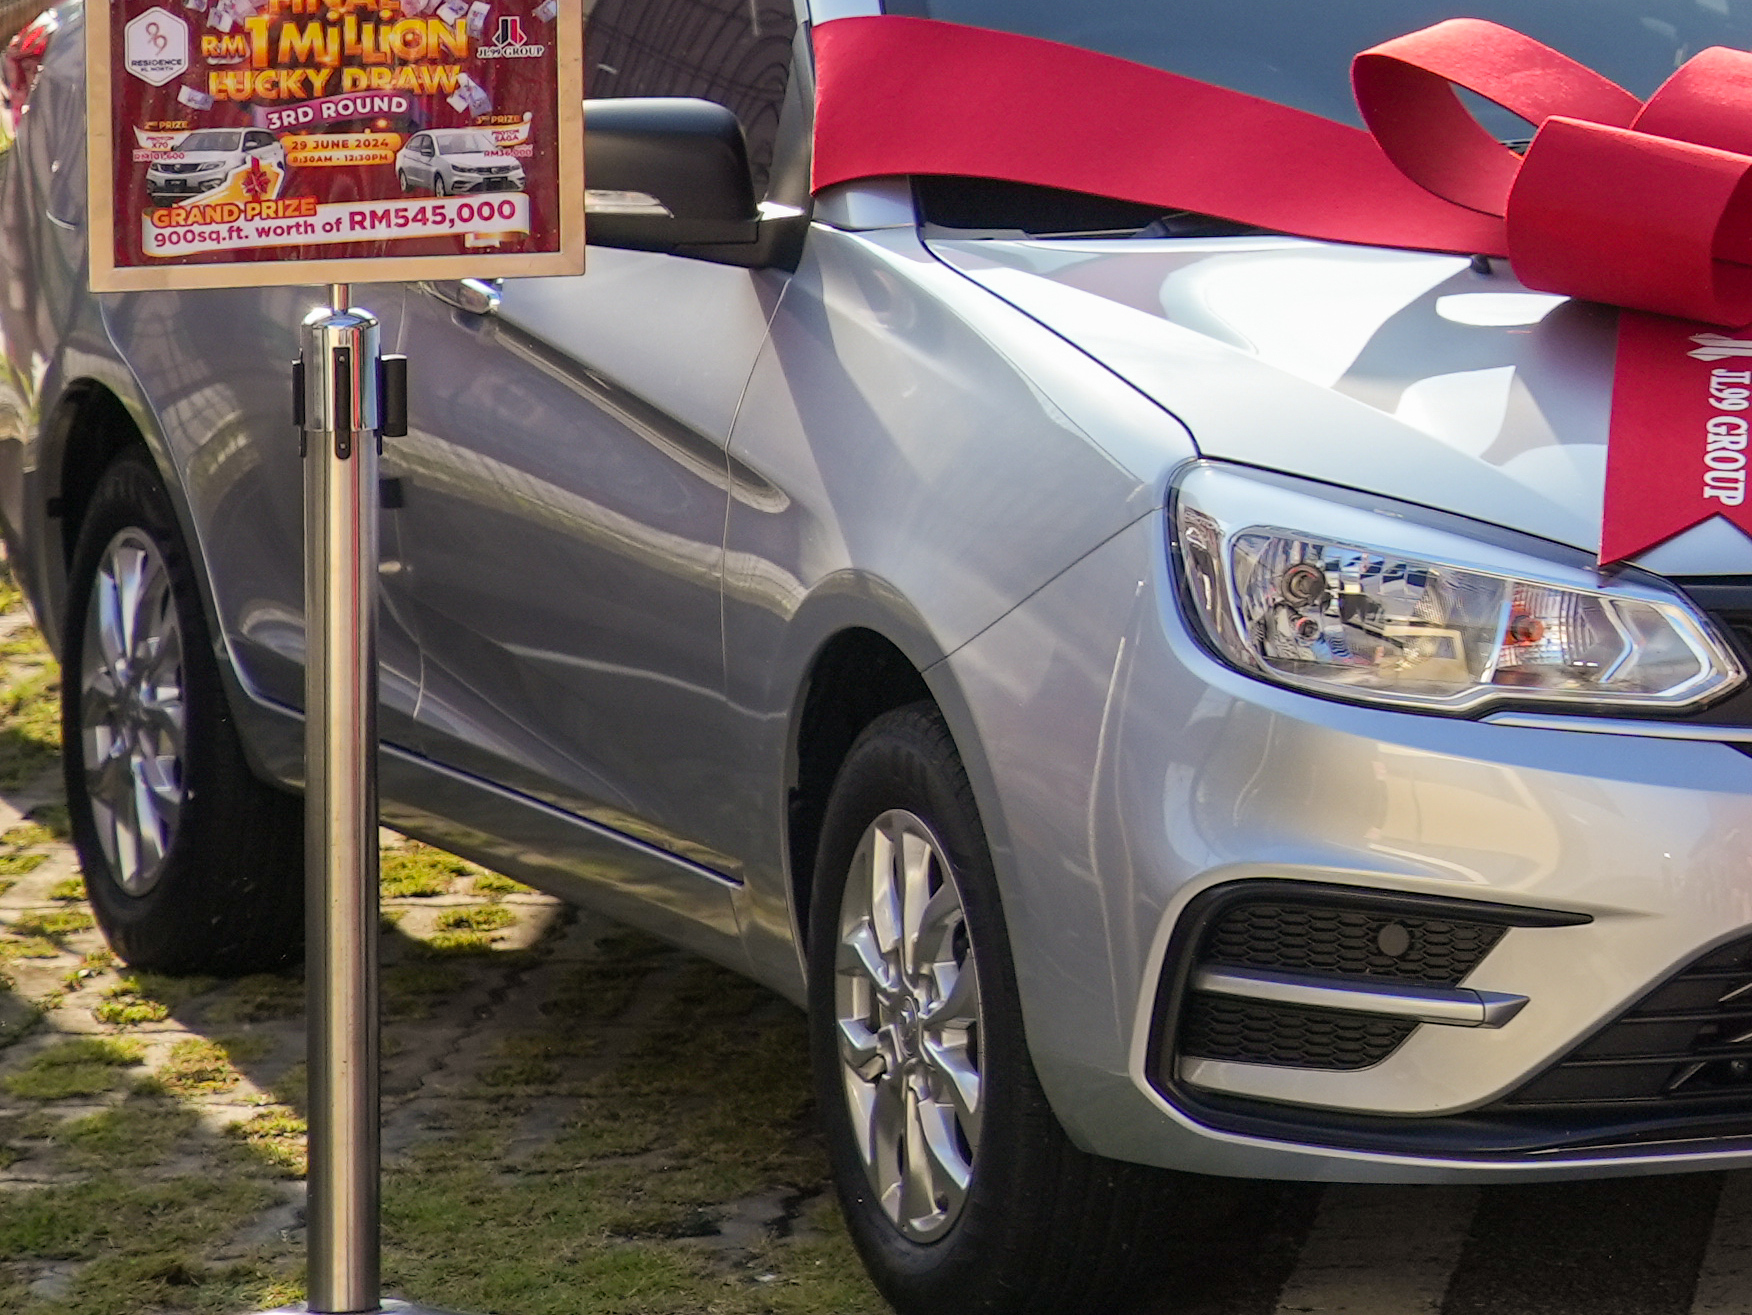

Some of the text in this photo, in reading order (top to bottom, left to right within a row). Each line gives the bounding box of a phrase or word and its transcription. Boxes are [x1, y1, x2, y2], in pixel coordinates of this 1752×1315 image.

[503, 46, 543, 56] GROUP
[131, 58, 182, 67] RESIDENCE
[207, 64, 462, 102] LUCKY DRAW
[267, 96, 408, 130] 3RD ROUND
[158, 120, 189, 129] PRIZE
[151, 141, 169, 149] X70
[291, 138, 389, 151] 29 JUNE 2024
[344, 153, 389, 162] 12:30PM
[151, 195, 317, 228] GRAND PRIZE
[154, 199, 516, 248] 900sq.ft. worth of RM545,000
[1702, 368, 1751, 506] JL99 GROUP
